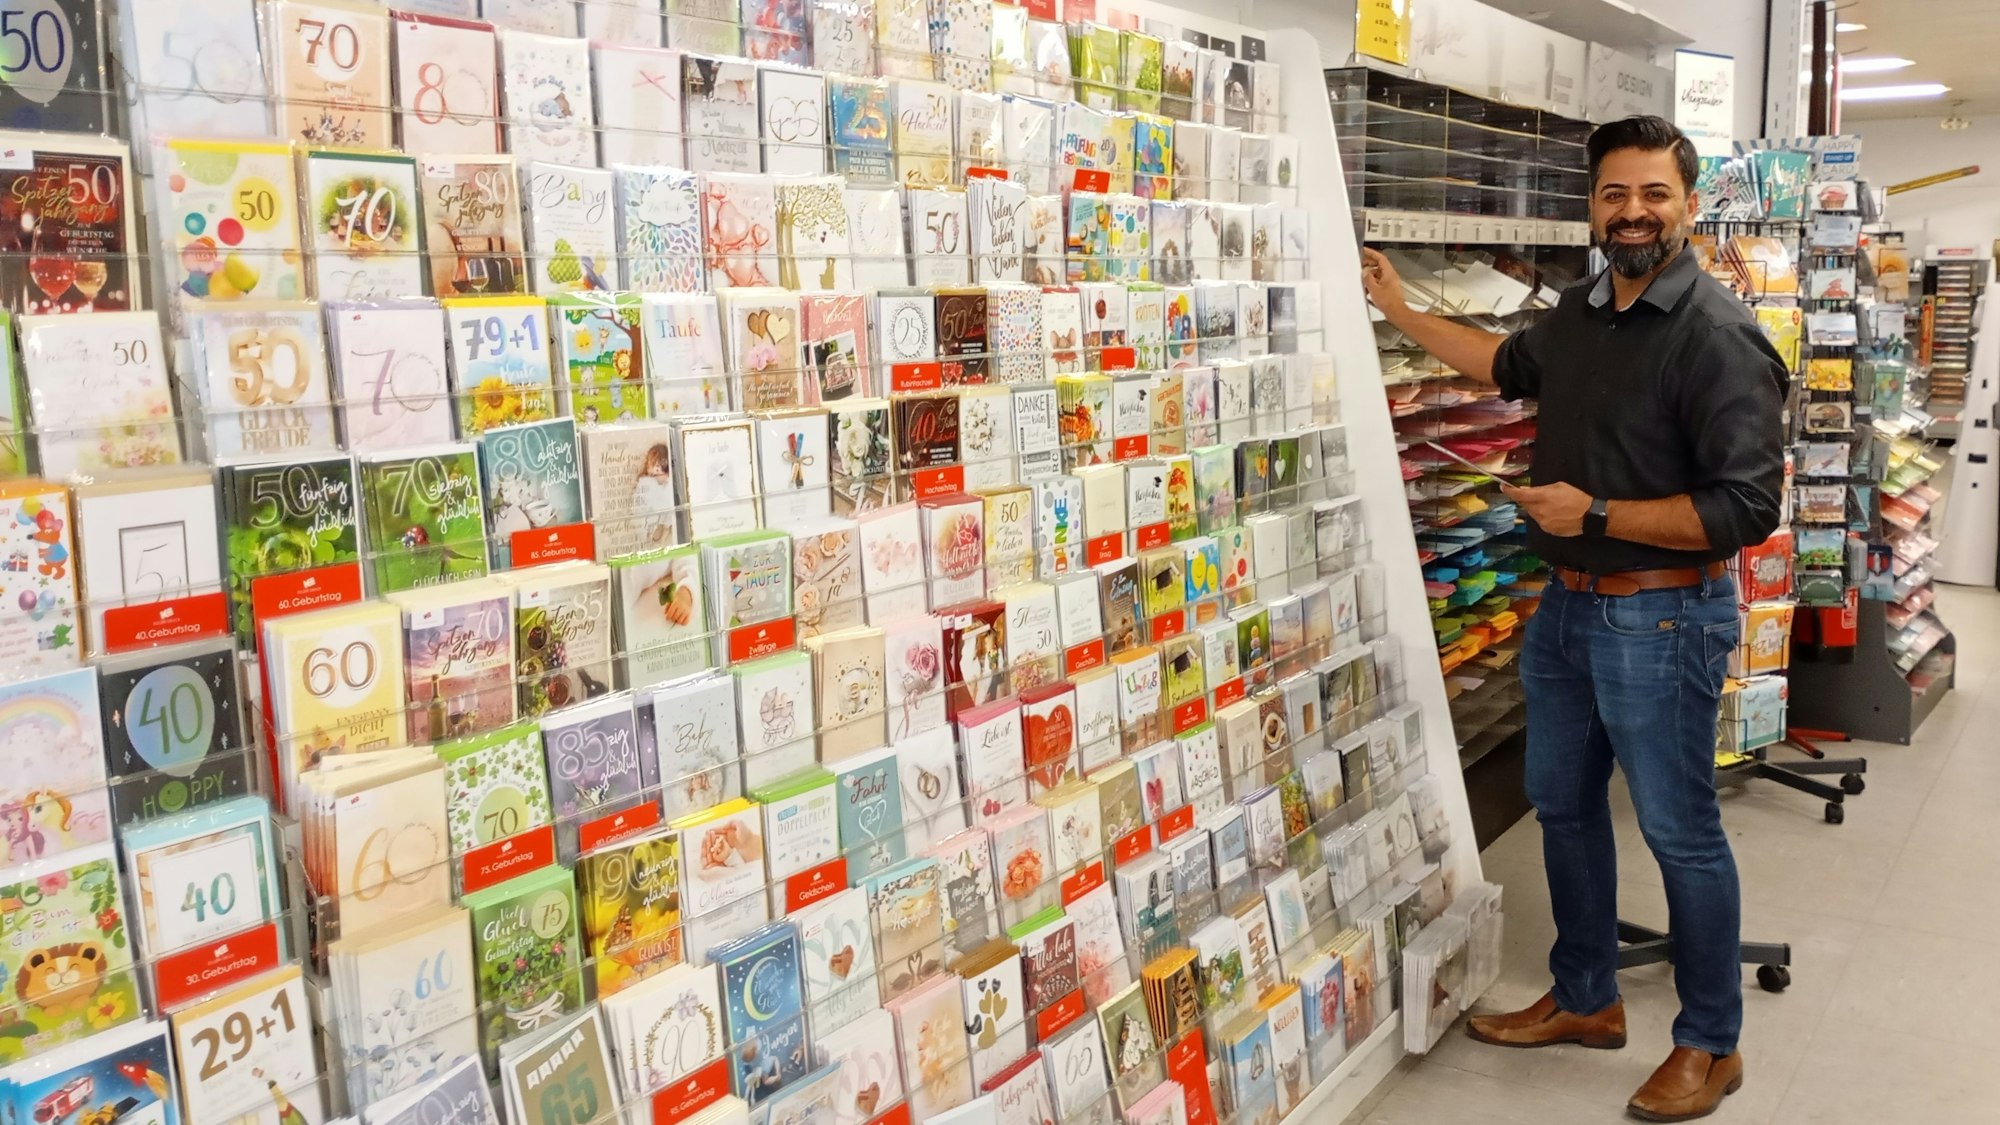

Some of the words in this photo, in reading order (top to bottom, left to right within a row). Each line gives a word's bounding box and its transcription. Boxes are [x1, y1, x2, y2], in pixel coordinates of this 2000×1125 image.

[0, 10, 66, 73] 50
[296, 18, 360, 70] 70
[832, 18, 853, 42] 25
[414, 62, 488, 126] 80
[1617, 72, 1653, 97] DESIGN
[1065, 134, 1096, 156] PRÜFUNG
[1823, 142, 1855, 151] HAPPY
[67, 164, 117, 205] 50
[1822, 164, 1854, 175] CARD
[474, 169, 509, 203] 80
[526, 172, 607, 225] Baby
[240, 190, 274, 221] 50
[335, 186, 396, 248] 70
[60, 229, 114, 239] GEBURTSTAG
[925, 211, 959, 254] 50
[461, 314, 539, 361] 79+1
[656, 318, 701, 338] Taufe
[899, 315, 921, 345] 25
[943, 311, 968, 342] 50
[113, 339, 147, 366] 50
[228, 327, 310, 406] 50
[351, 349, 441, 417] 70
[500, 364, 535, 382] Heute
[520, 391, 546, 410] Tag!
[1018, 396, 1045, 413] DANKE
[242, 427, 310, 450] FREUDE
[910, 413, 936, 444] 40
[494, 426, 550, 480] 80
[250, 463, 320, 530] 50
[298, 478, 347, 508] fünfzig
[380, 456, 449, 517] 70
[1001, 502, 1019, 522] 50
[530, 550, 542, 559] 85.
[542, 546, 577, 559] Geburtstag
[753, 556, 771, 568] ZUR
[746, 573, 782, 589] TAUFE
[278, 598, 292, 610] 60.
[292, 591, 341, 608] Geburtstag
[573, 588, 602, 622] 85
[135, 630, 149, 641] 40.
[149, 623, 201, 639] Geburtstag
[468, 608, 504, 642] 70
[1036, 630, 1051, 649] 50
[749, 641, 777, 655] Zwillinge
[301, 641, 376, 698] 60
[139, 682, 203, 755] 40
[349, 719, 385, 738] DICH!
[675, 712, 715, 753] Baby
[556, 720, 608, 780] 85
[851, 772, 888, 804] Fahrt
[483, 806, 519, 840] 70
[777, 807, 831, 836] DOPPELPACK!
[352, 822, 439, 902] 60
[480, 864, 492, 876] 75.
[492, 850, 534, 871] Geburtstag
[600, 847, 655, 901] 90
[181, 873, 236, 922] 40
[800, 882, 836, 902] Geldschein
[485, 935, 534, 963] Geburtstag
[185, 974, 200, 986] 30.
[201, 955, 257, 981] Geburtstag
[415, 949, 453, 1000] 60
[191, 985, 296, 1082] 29+1
[541, 1062, 599, 1125] 65
[680, 1087, 715, 1112] Geburtstag
